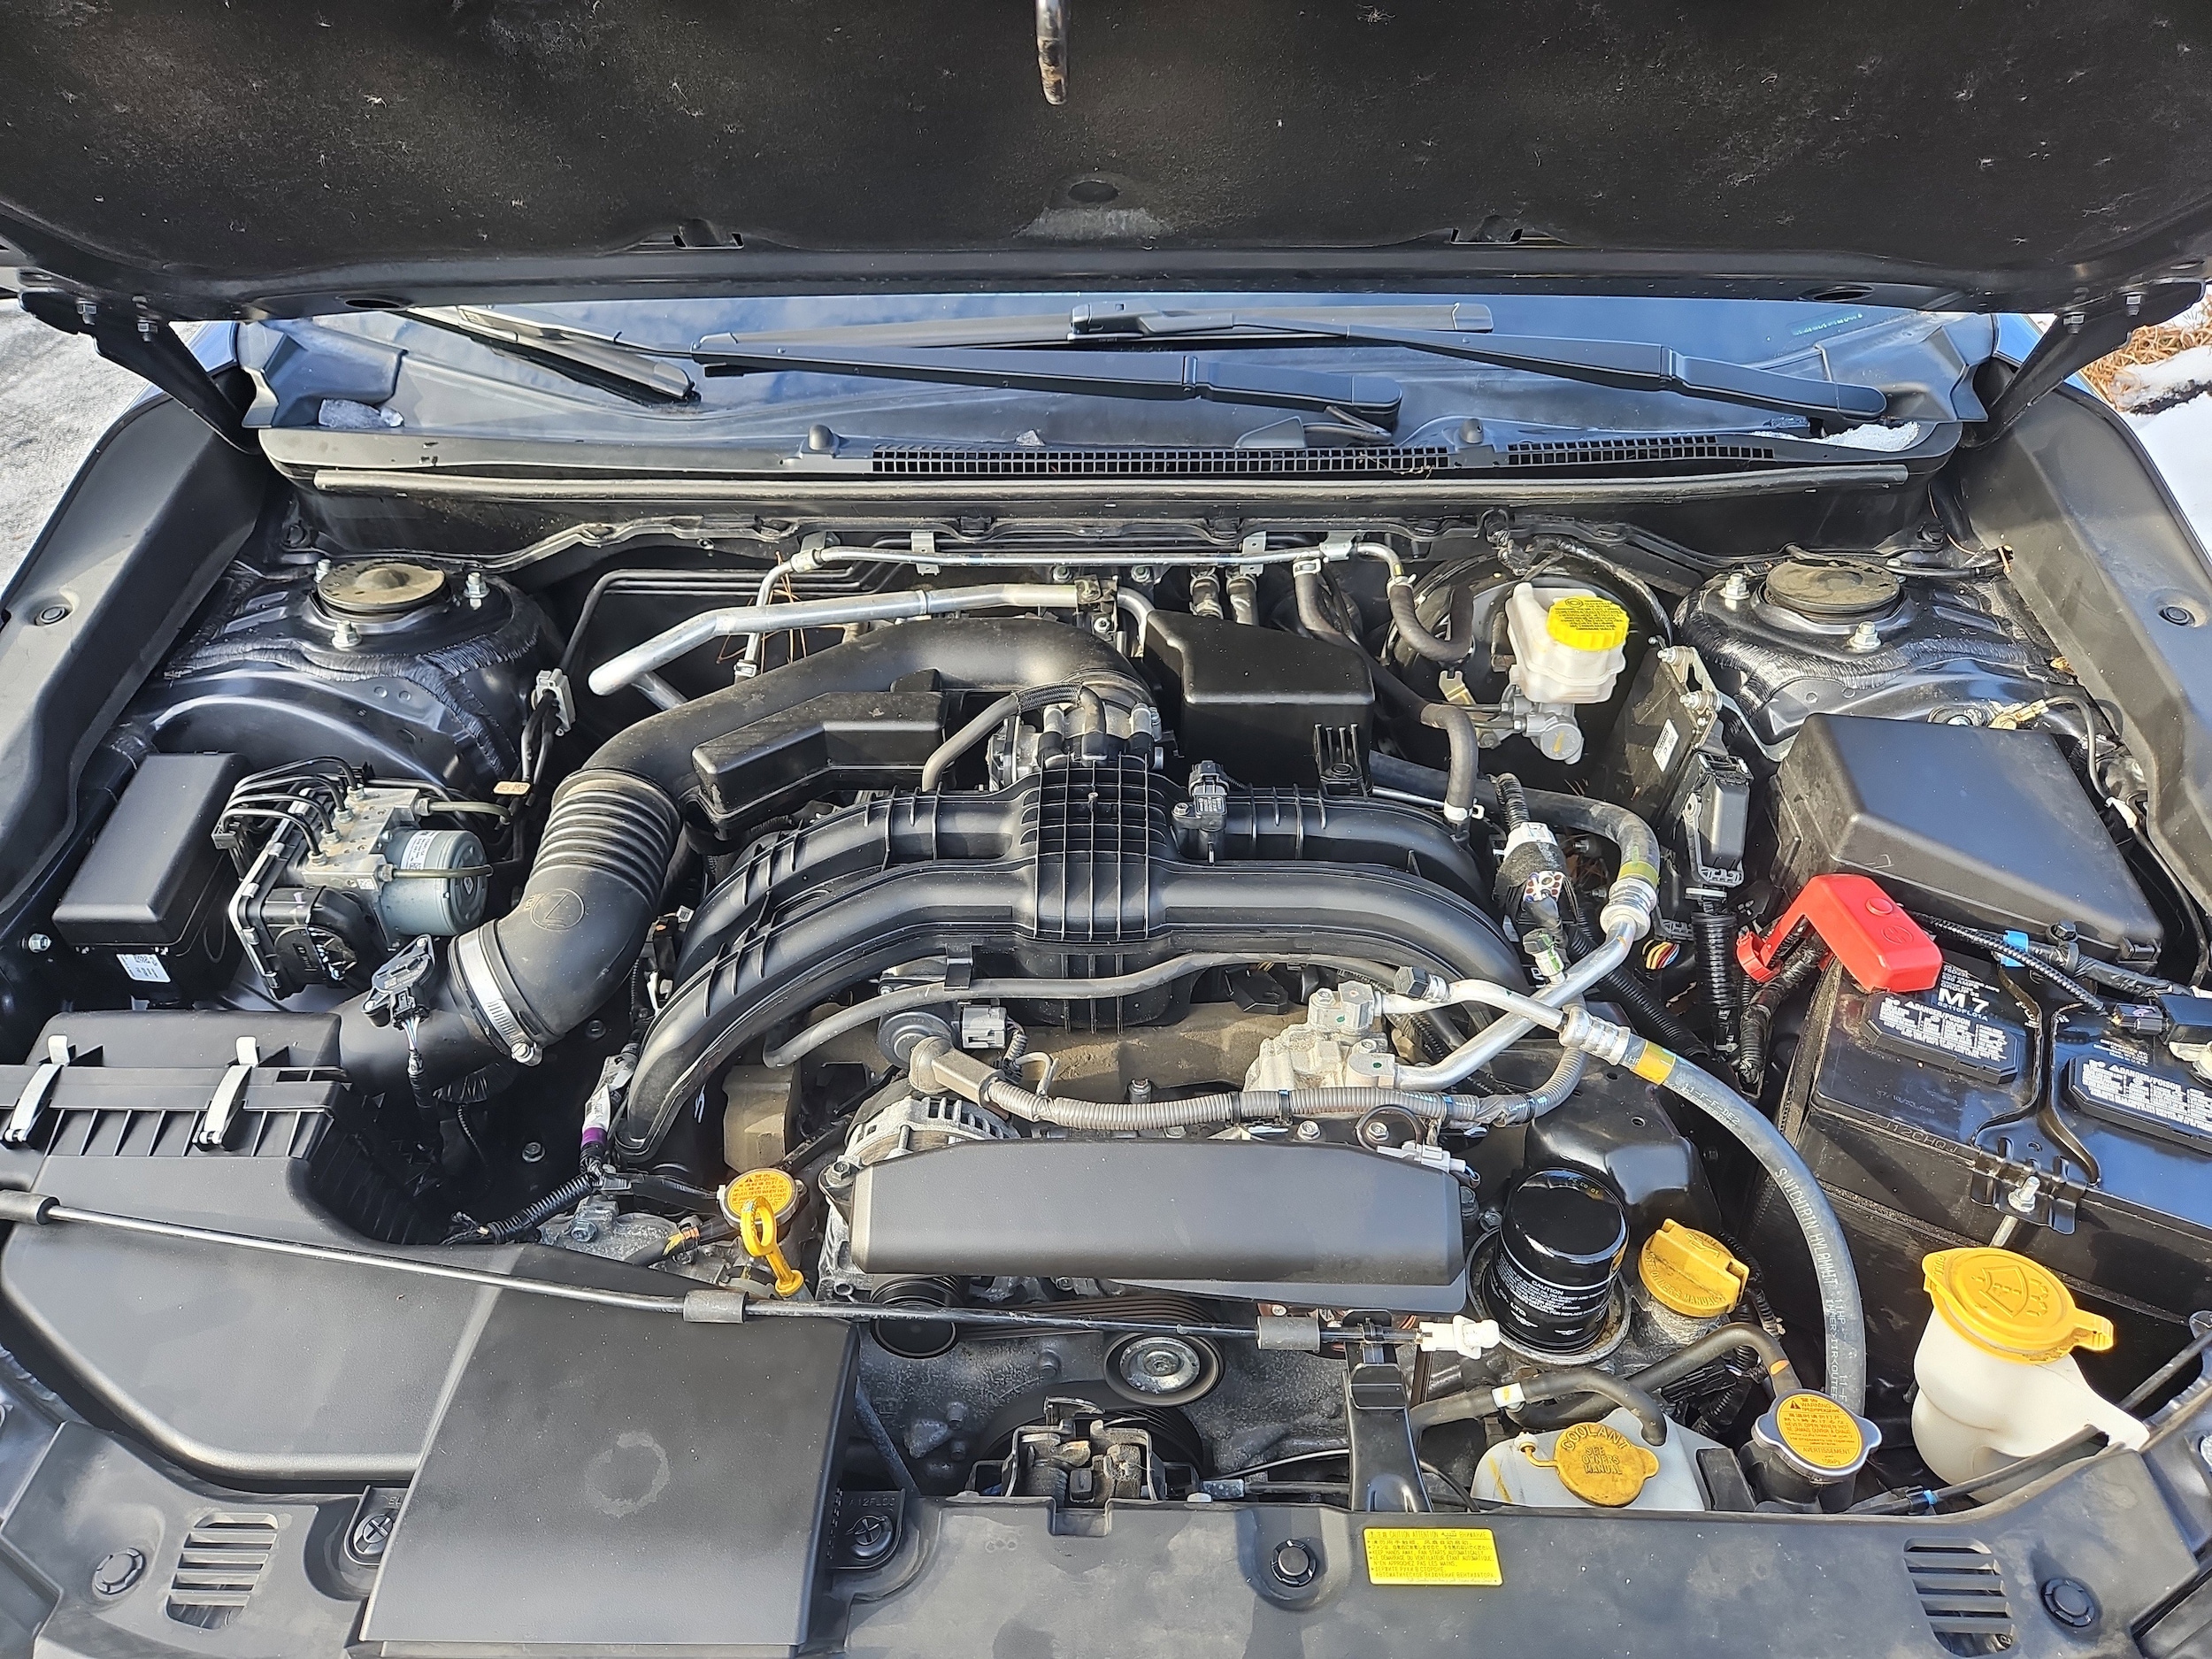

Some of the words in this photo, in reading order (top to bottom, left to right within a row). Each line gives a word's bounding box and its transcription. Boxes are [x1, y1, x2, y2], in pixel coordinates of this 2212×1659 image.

[1940, 982, 1969, 994] GROUP
[1938, 987, 1966, 1009] M
[1971, 997, 1990, 1013] 7
[1531, 1279, 1564, 1296] CAUTION
[1646, 1256, 1658, 1271] SEE
[1683, 1293, 1718, 1306] MANUAL
[1509, 1301, 1527, 1317] LTD
[1560, 1424, 1632, 1452] COOLANT
[1585, 1446, 1606, 1455] SEE
[1581, 1455, 1621, 1465] OWNERS
[1583, 1463, 1623, 1475] MANUAL
